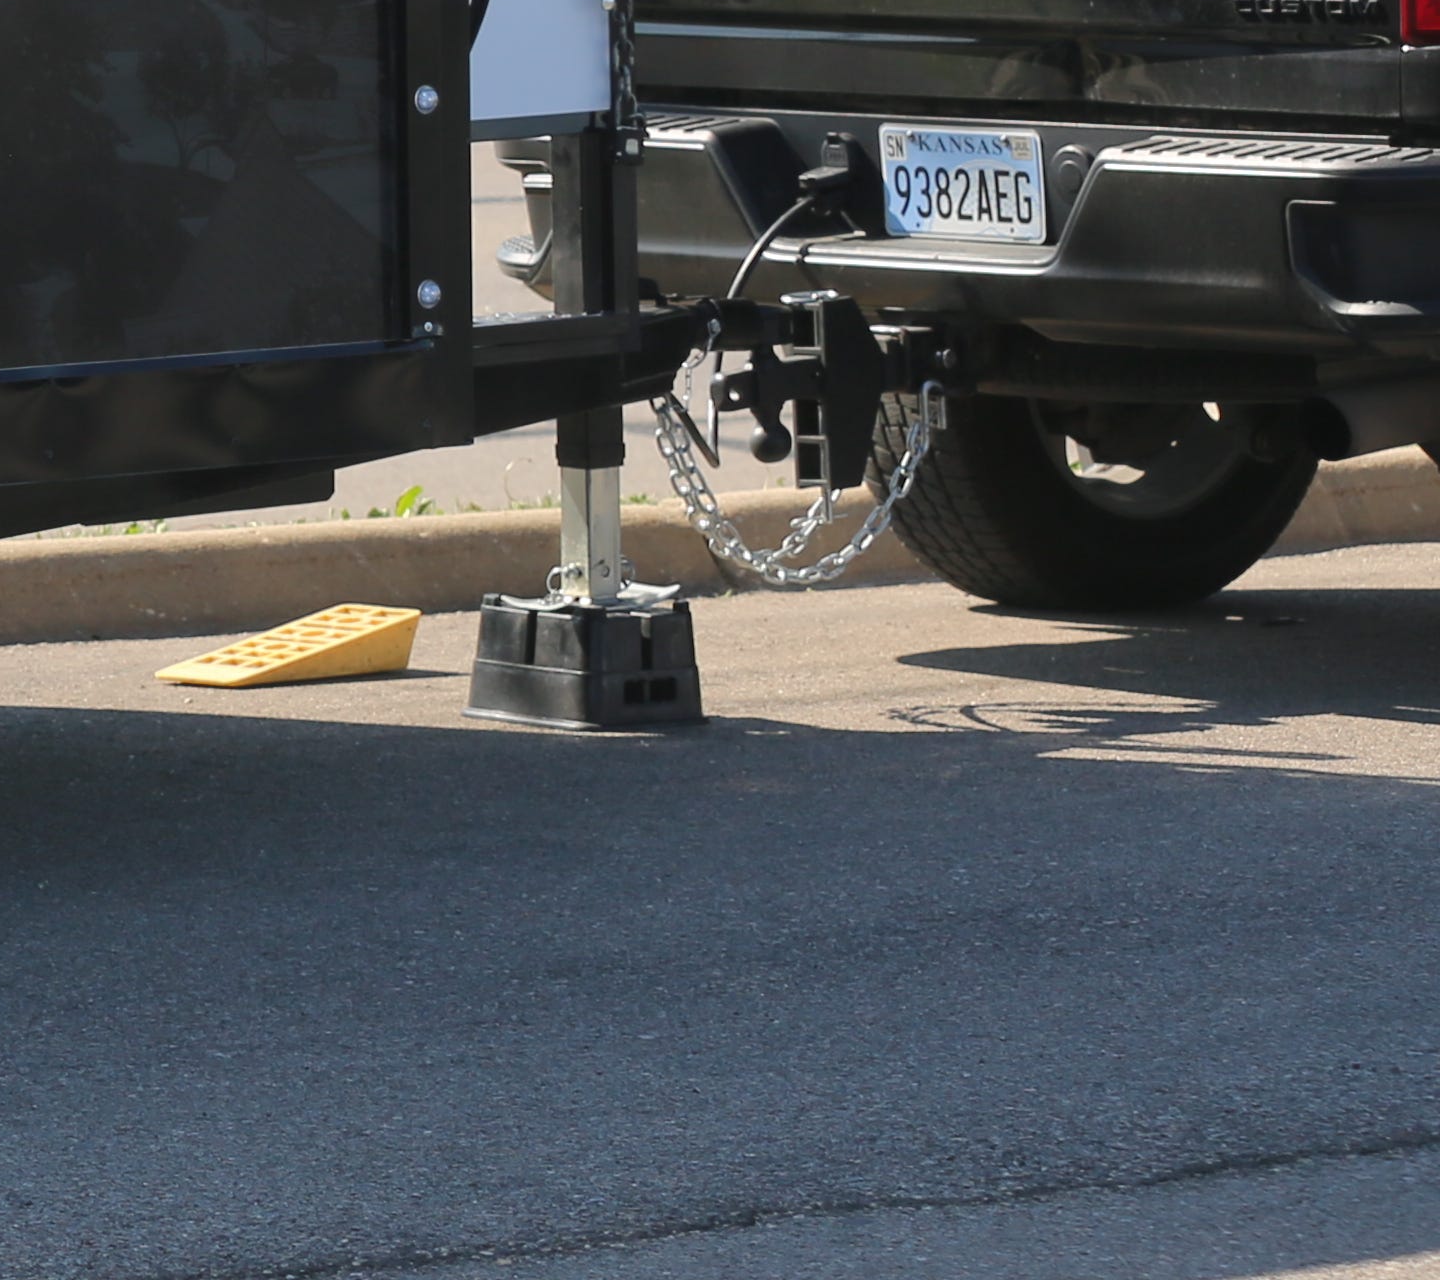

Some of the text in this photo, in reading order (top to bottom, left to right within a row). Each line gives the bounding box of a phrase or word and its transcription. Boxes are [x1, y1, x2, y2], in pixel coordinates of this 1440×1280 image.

[887, 135, 904, 157] SN
[918, 135, 1003, 155] KANSAS
[894, 165, 1032, 224] 9382AEG
